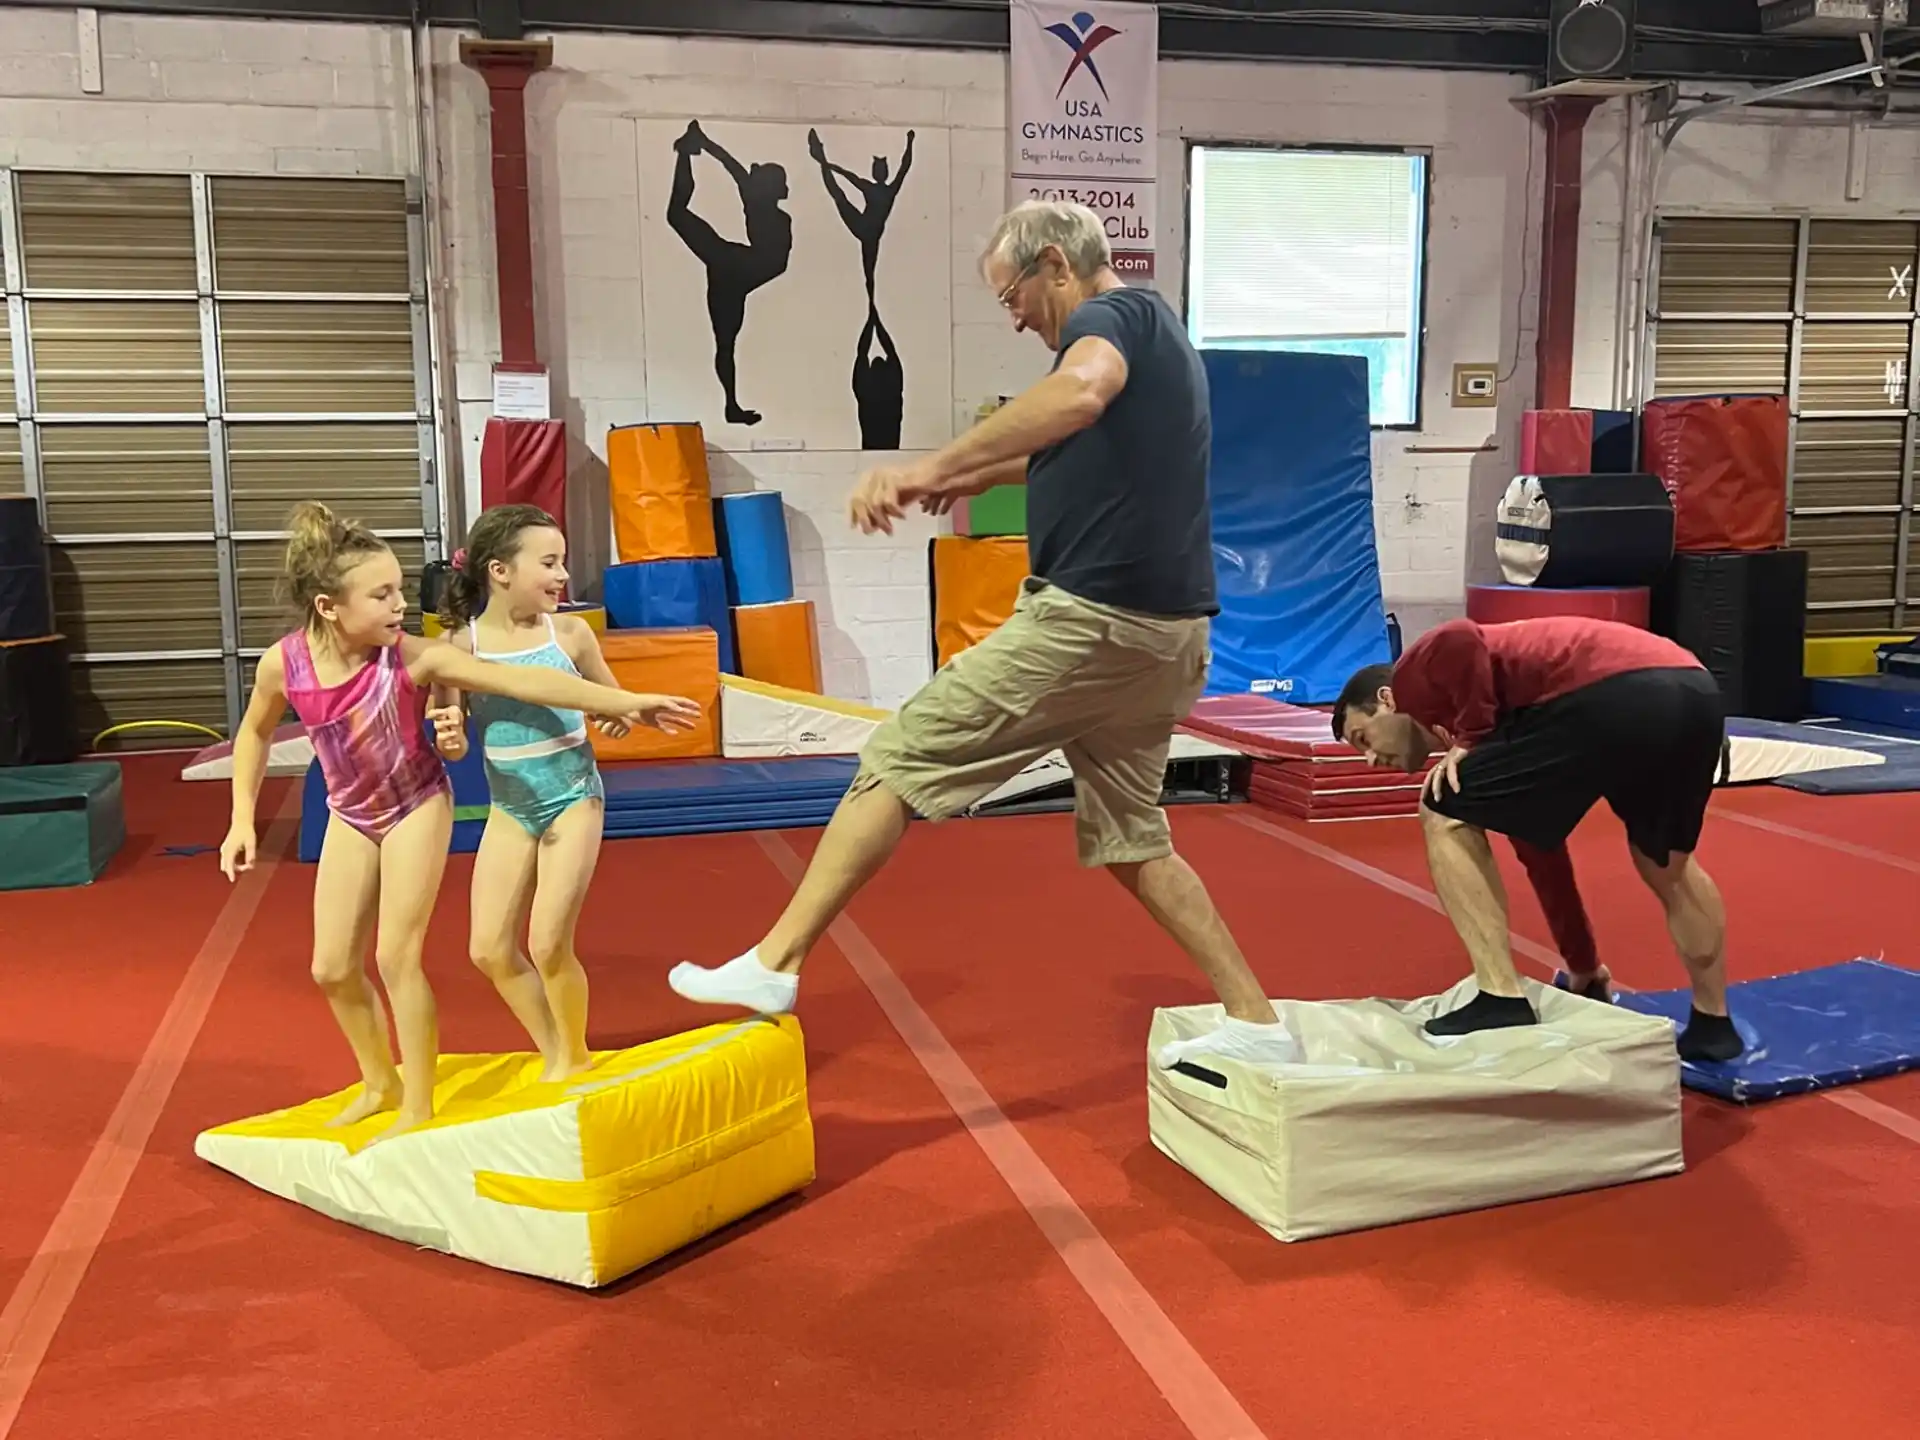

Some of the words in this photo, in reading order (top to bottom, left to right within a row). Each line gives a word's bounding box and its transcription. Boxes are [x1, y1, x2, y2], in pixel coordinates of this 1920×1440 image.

[1065, 100, 1102, 118] USA
[1022, 122, 1144, 143] GYMNASTICS
[1021, 148, 1048, 165] Begin
[1078, 150, 1095, 163] Go
[1030, 188, 1135, 209] 2013-2014
[1103, 215, 1149, 239] Club
